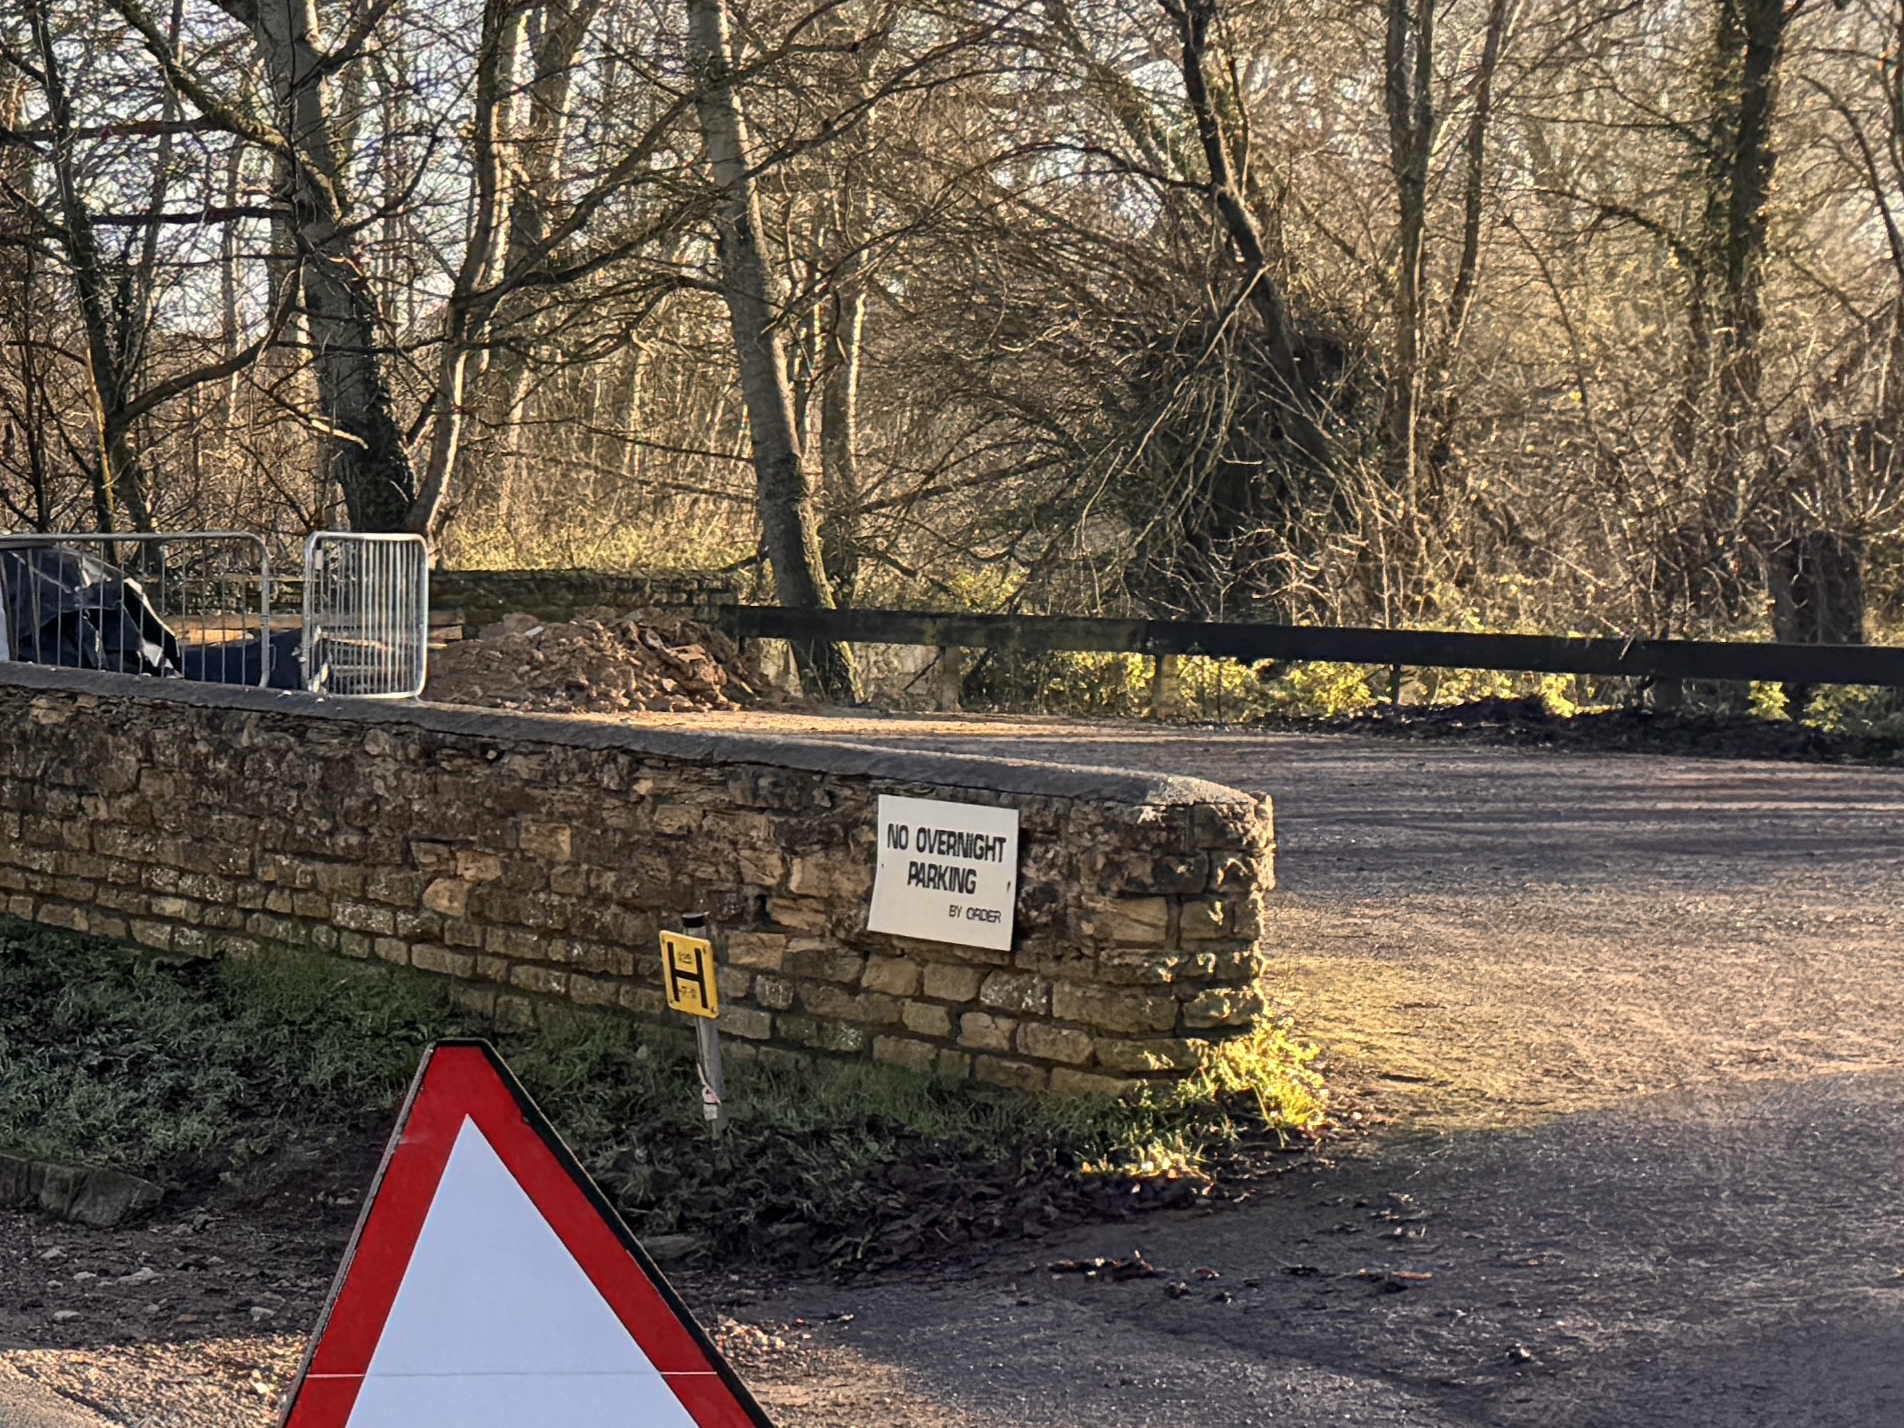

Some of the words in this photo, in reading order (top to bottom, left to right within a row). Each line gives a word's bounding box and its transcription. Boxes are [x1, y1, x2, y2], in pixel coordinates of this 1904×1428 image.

[887, 823, 909, 850] NO
[916, 827, 1007, 863] OVERNIGHT
[907, 861, 977, 894] PARKING
[948, 904, 962, 919] BY
[966, 906, 1002, 923] ORDER
[667, 941, 709, 1009] H
